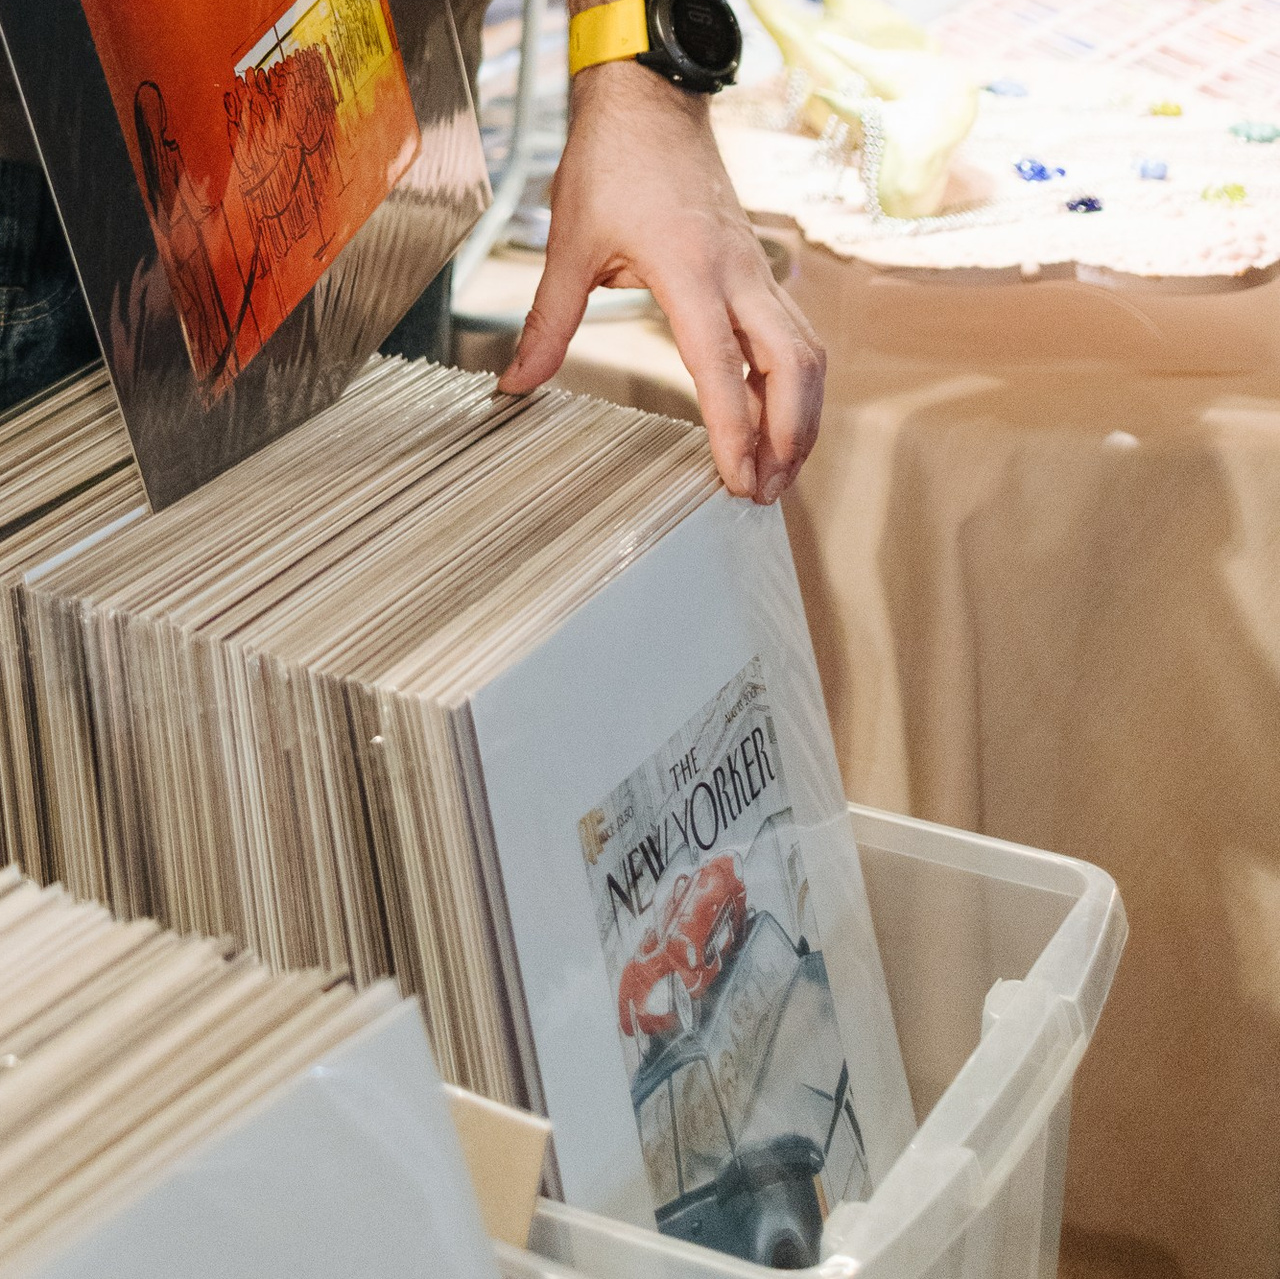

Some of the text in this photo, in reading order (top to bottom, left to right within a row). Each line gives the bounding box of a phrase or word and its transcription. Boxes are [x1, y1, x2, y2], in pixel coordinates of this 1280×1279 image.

[605, 816, 669, 938] NEW
[671, 725, 775, 852] YORKER
[668, 745, 701, 793] THE
